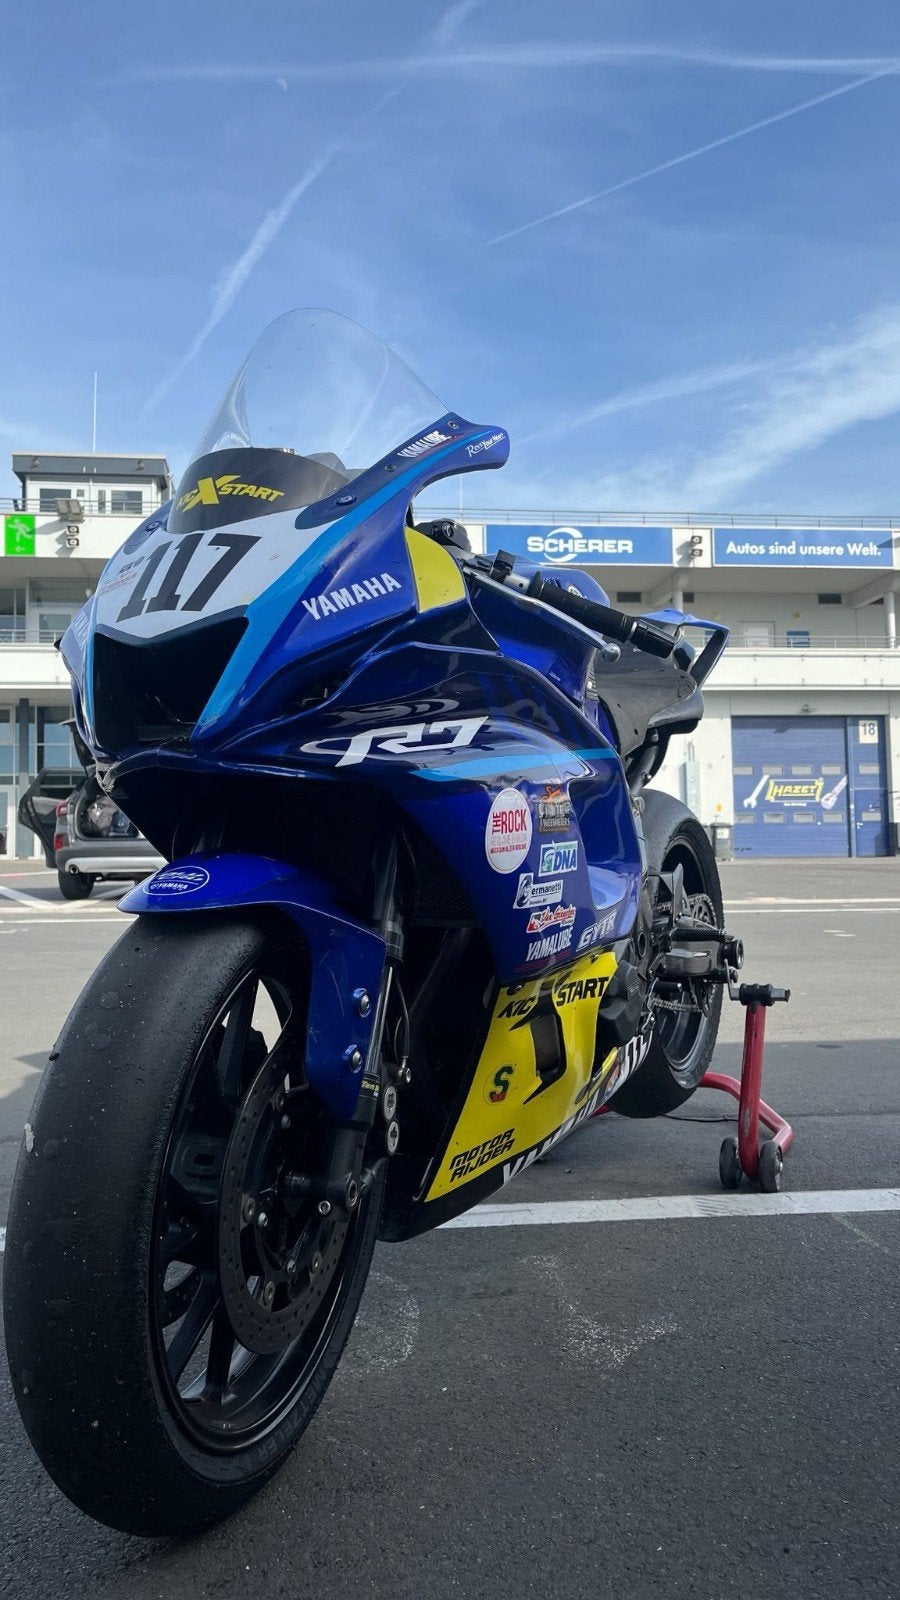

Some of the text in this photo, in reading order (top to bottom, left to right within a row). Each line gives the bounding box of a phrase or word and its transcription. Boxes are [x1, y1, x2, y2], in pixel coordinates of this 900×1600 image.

[527, 536, 633, 554] SCHERER
[726, 541, 882, 556] Autos sind unsere Welt.
[116, 532, 262, 623] 117
[302, 573, 402, 620] YAMAHA
[335, 715, 490, 767] R7
[862, 722, 876, 736] 18
[773, 785, 817, 797] HAZET
[491, 809, 527, 835] THE ROCK
[553, 849, 577, 872] DNA
[526, 927, 573, 961] YAMALUBE
[577, 910, 617, 951] GYTR
[556, 976, 609, 1007] START
